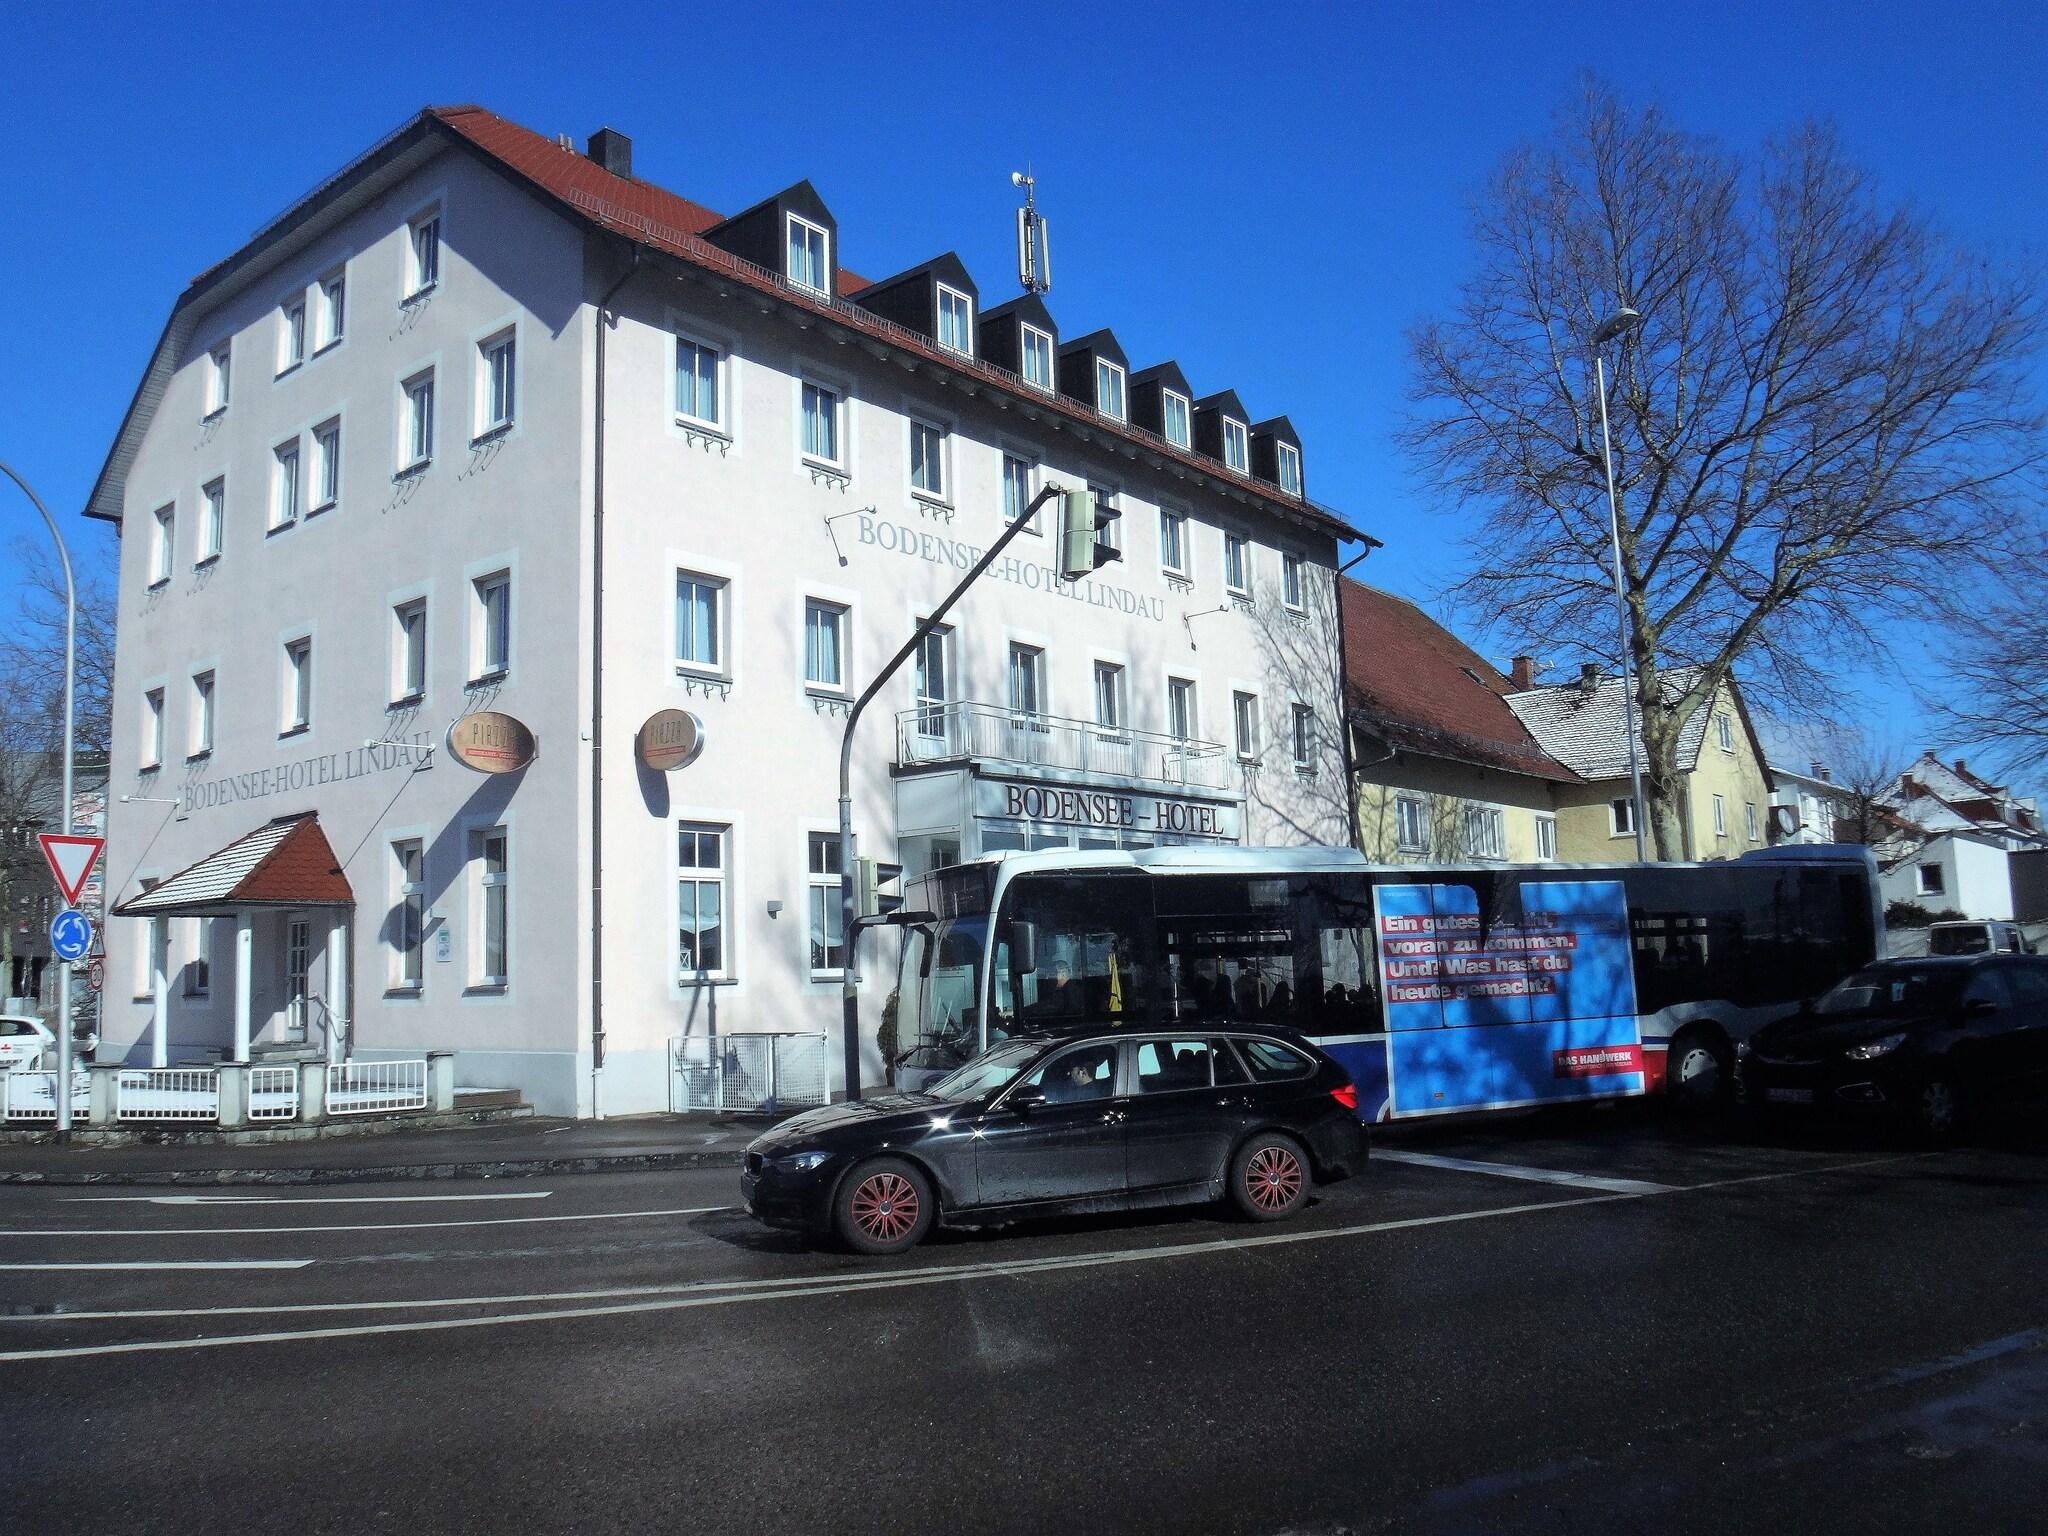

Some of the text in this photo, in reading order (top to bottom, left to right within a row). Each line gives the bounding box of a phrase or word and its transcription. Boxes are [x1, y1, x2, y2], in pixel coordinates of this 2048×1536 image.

[1087, 580, 1165, 622] LINDAU
[184, 730, 432, 813] BODENSEE-HOTEL LINDAU
[1005, 784, 1133, 826] BODENSEE
[1155, 801, 1224, 835] HOTEL
[1385, 915, 1418, 931] Ein
[1423, 915, 1480, 933] gutes
[1387, 939, 1448, 954] voran
[1453, 939, 1478, 952] zu
[1390, 955, 1569, 977] Und? Was hast du
[1391, 977, 1550, 1000] heute gemacht?
[1558, 1055, 1578, 1066] DAS
